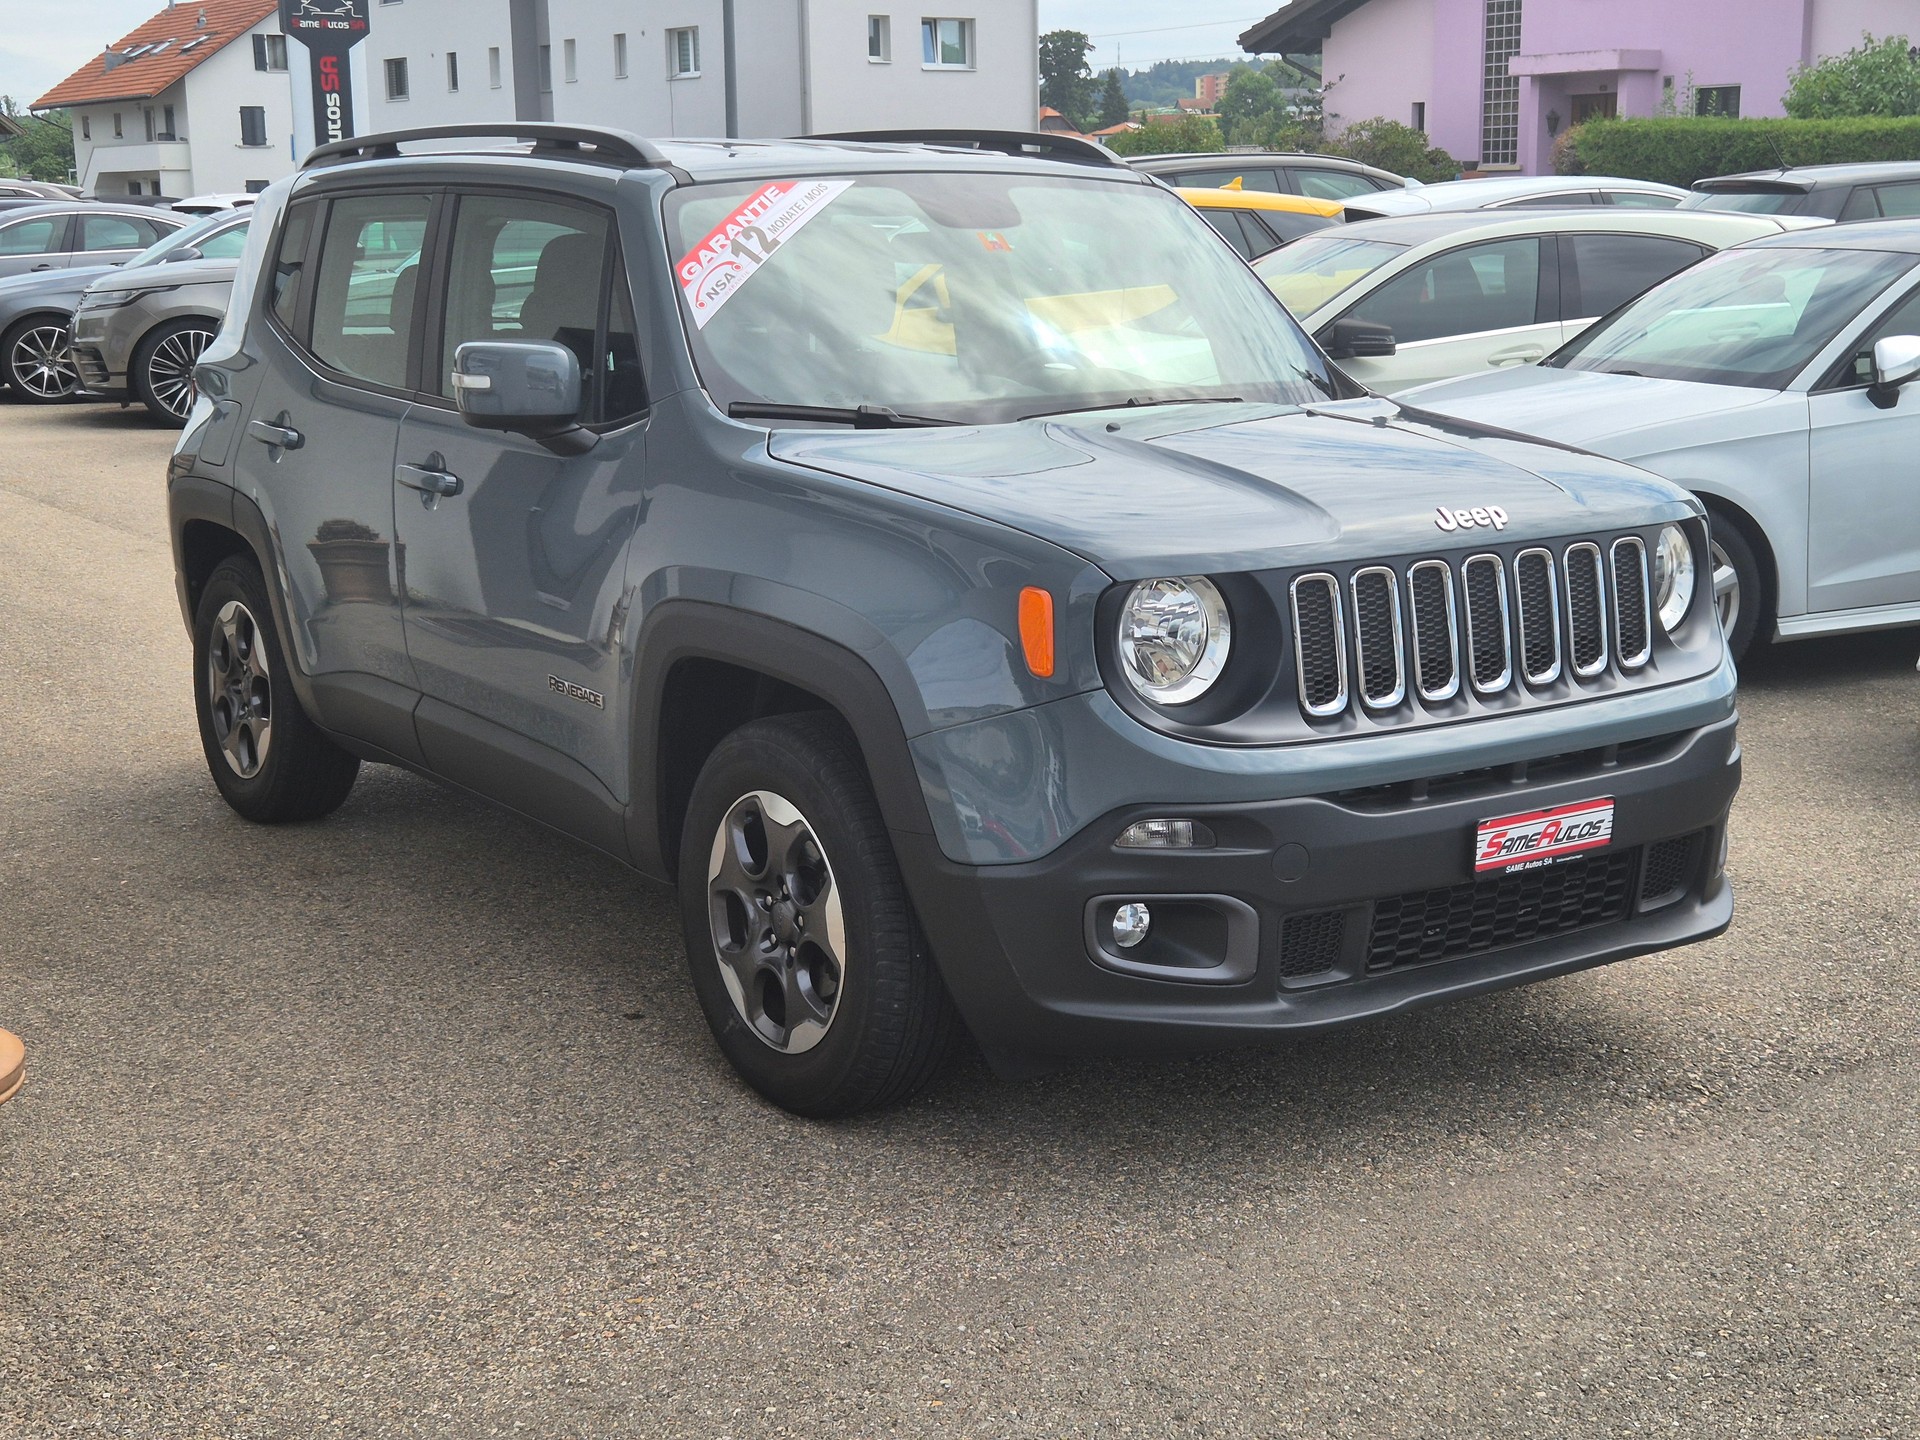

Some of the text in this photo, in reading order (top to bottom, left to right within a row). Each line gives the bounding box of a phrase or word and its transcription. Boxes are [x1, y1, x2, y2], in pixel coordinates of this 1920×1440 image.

[326, 92, 343, 143] utos
[681, 186, 784, 281] GARANTIE
[730, 225, 781, 265] 12
[767, 202, 805, 235] MONATE
[805, 183, 829, 203] MOIS
[705, 272, 736, 301] NSA
[1434, 505, 1508, 532] Jeep
[547, 674, 604, 710] RENEGADE
[1505, 862, 1524, 873] SAME
[1525, 860, 1543, 869] Autos
[1543, 857, 1553, 865] SA
